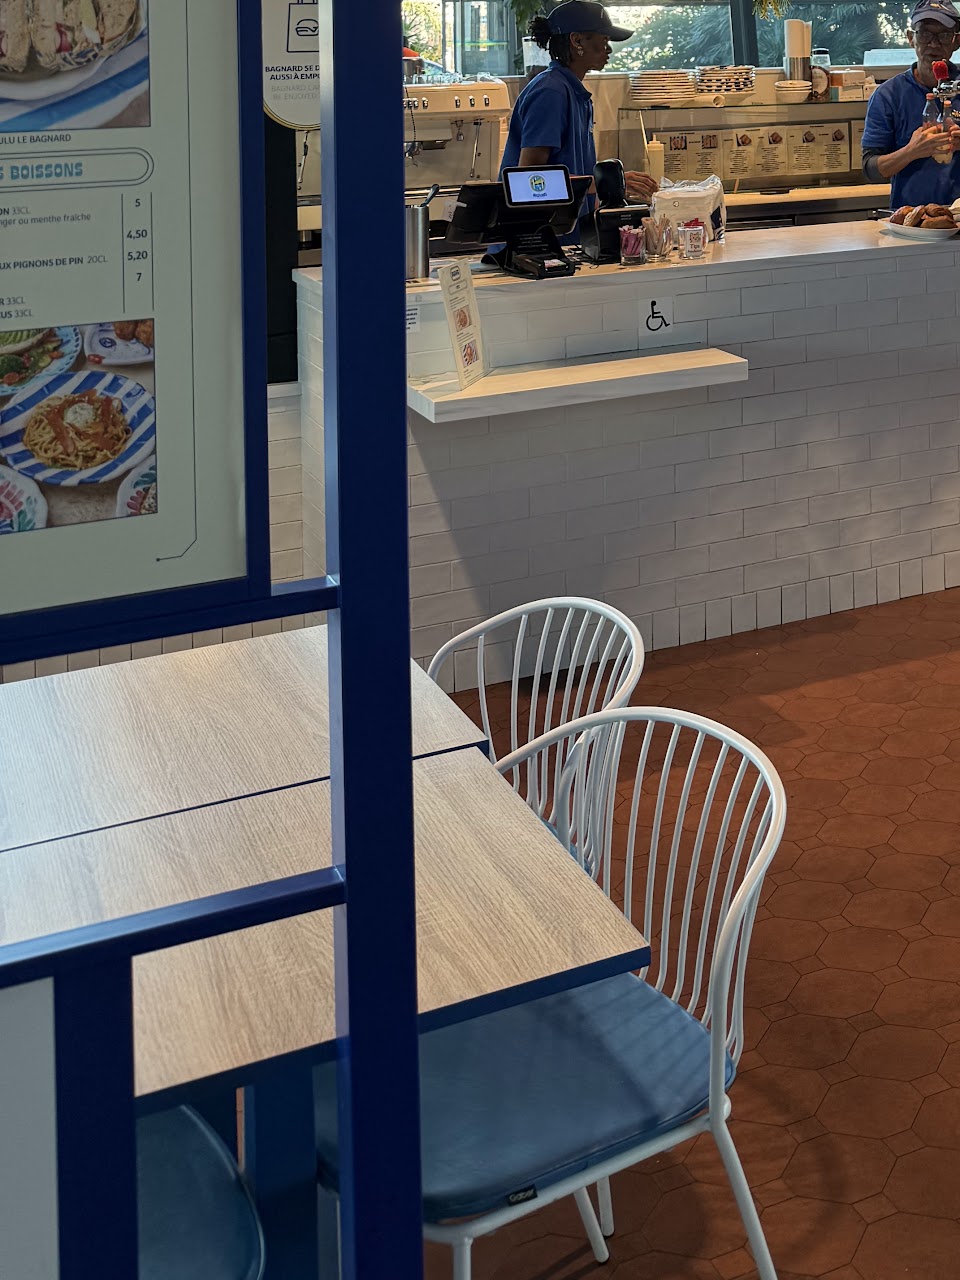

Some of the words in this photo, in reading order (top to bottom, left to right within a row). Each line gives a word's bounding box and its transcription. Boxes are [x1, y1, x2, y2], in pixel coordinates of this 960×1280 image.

[265, 65, 304, 73] BAGNARD
[269, 73, 293, 81] AUSSI
[17, 136, 27, 144] LE
[29, 133, 72, 143] BAGNARD
[10, 162, 83, 180] BOISSONS
[135, 198, 141, 208] 5
[30, 215, 61, 224] menthe
[63, 212, 91, 222] fraîche
[126, 229, 148, 239] 4,50
[127, 250, 148, 261] 5,20
[13, 259, 54, 269] PIGNONS
[55, 257, 67, 266] DE
[69, 256, 84, 265] PIN
[87, 255, 108, 264] 20CL
[136, 272, 142, 282] 7
[6, 296, 26, 305] 33CL
[0, 310, 12, 319] US
